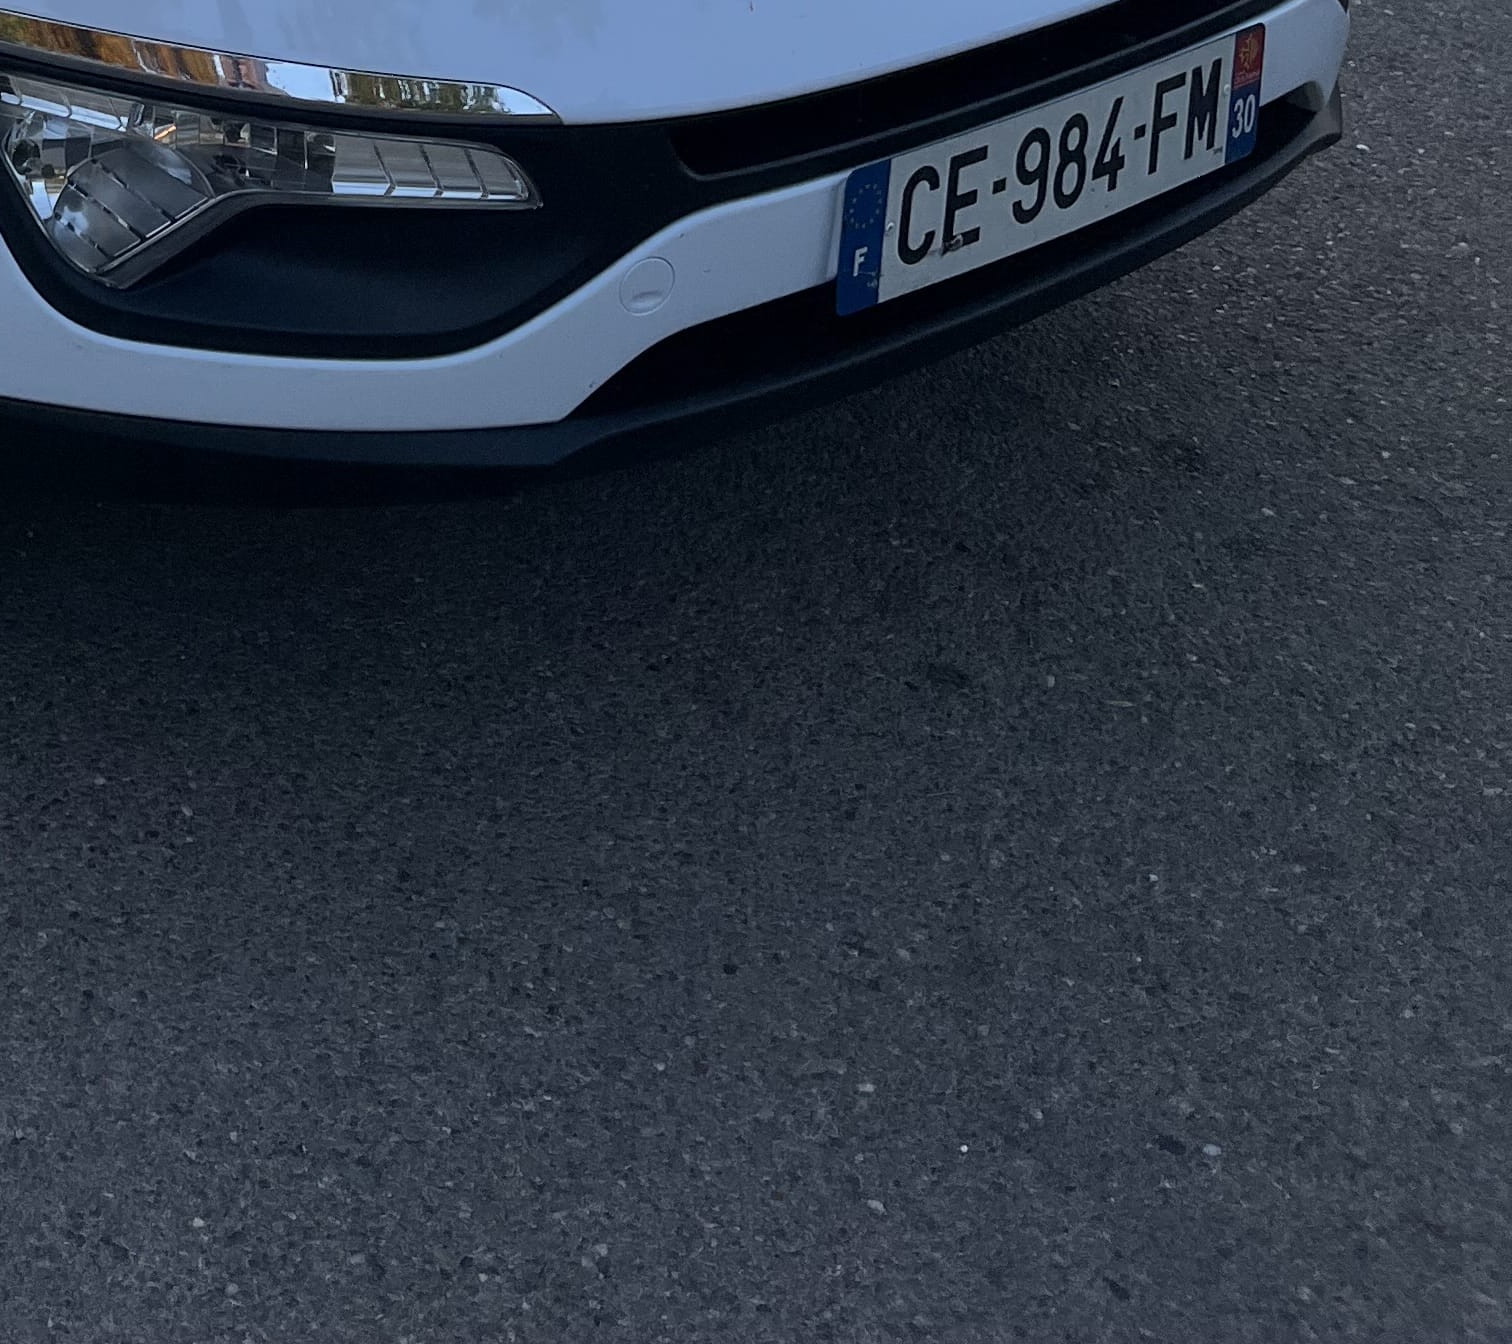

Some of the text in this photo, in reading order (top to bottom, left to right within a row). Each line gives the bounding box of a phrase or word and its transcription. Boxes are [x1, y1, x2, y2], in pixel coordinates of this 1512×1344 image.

[1231, 93, 1256, 139] 30
[897, 58, 1222, 265] CE-984-FM
[852, 246, 869, 277] F
